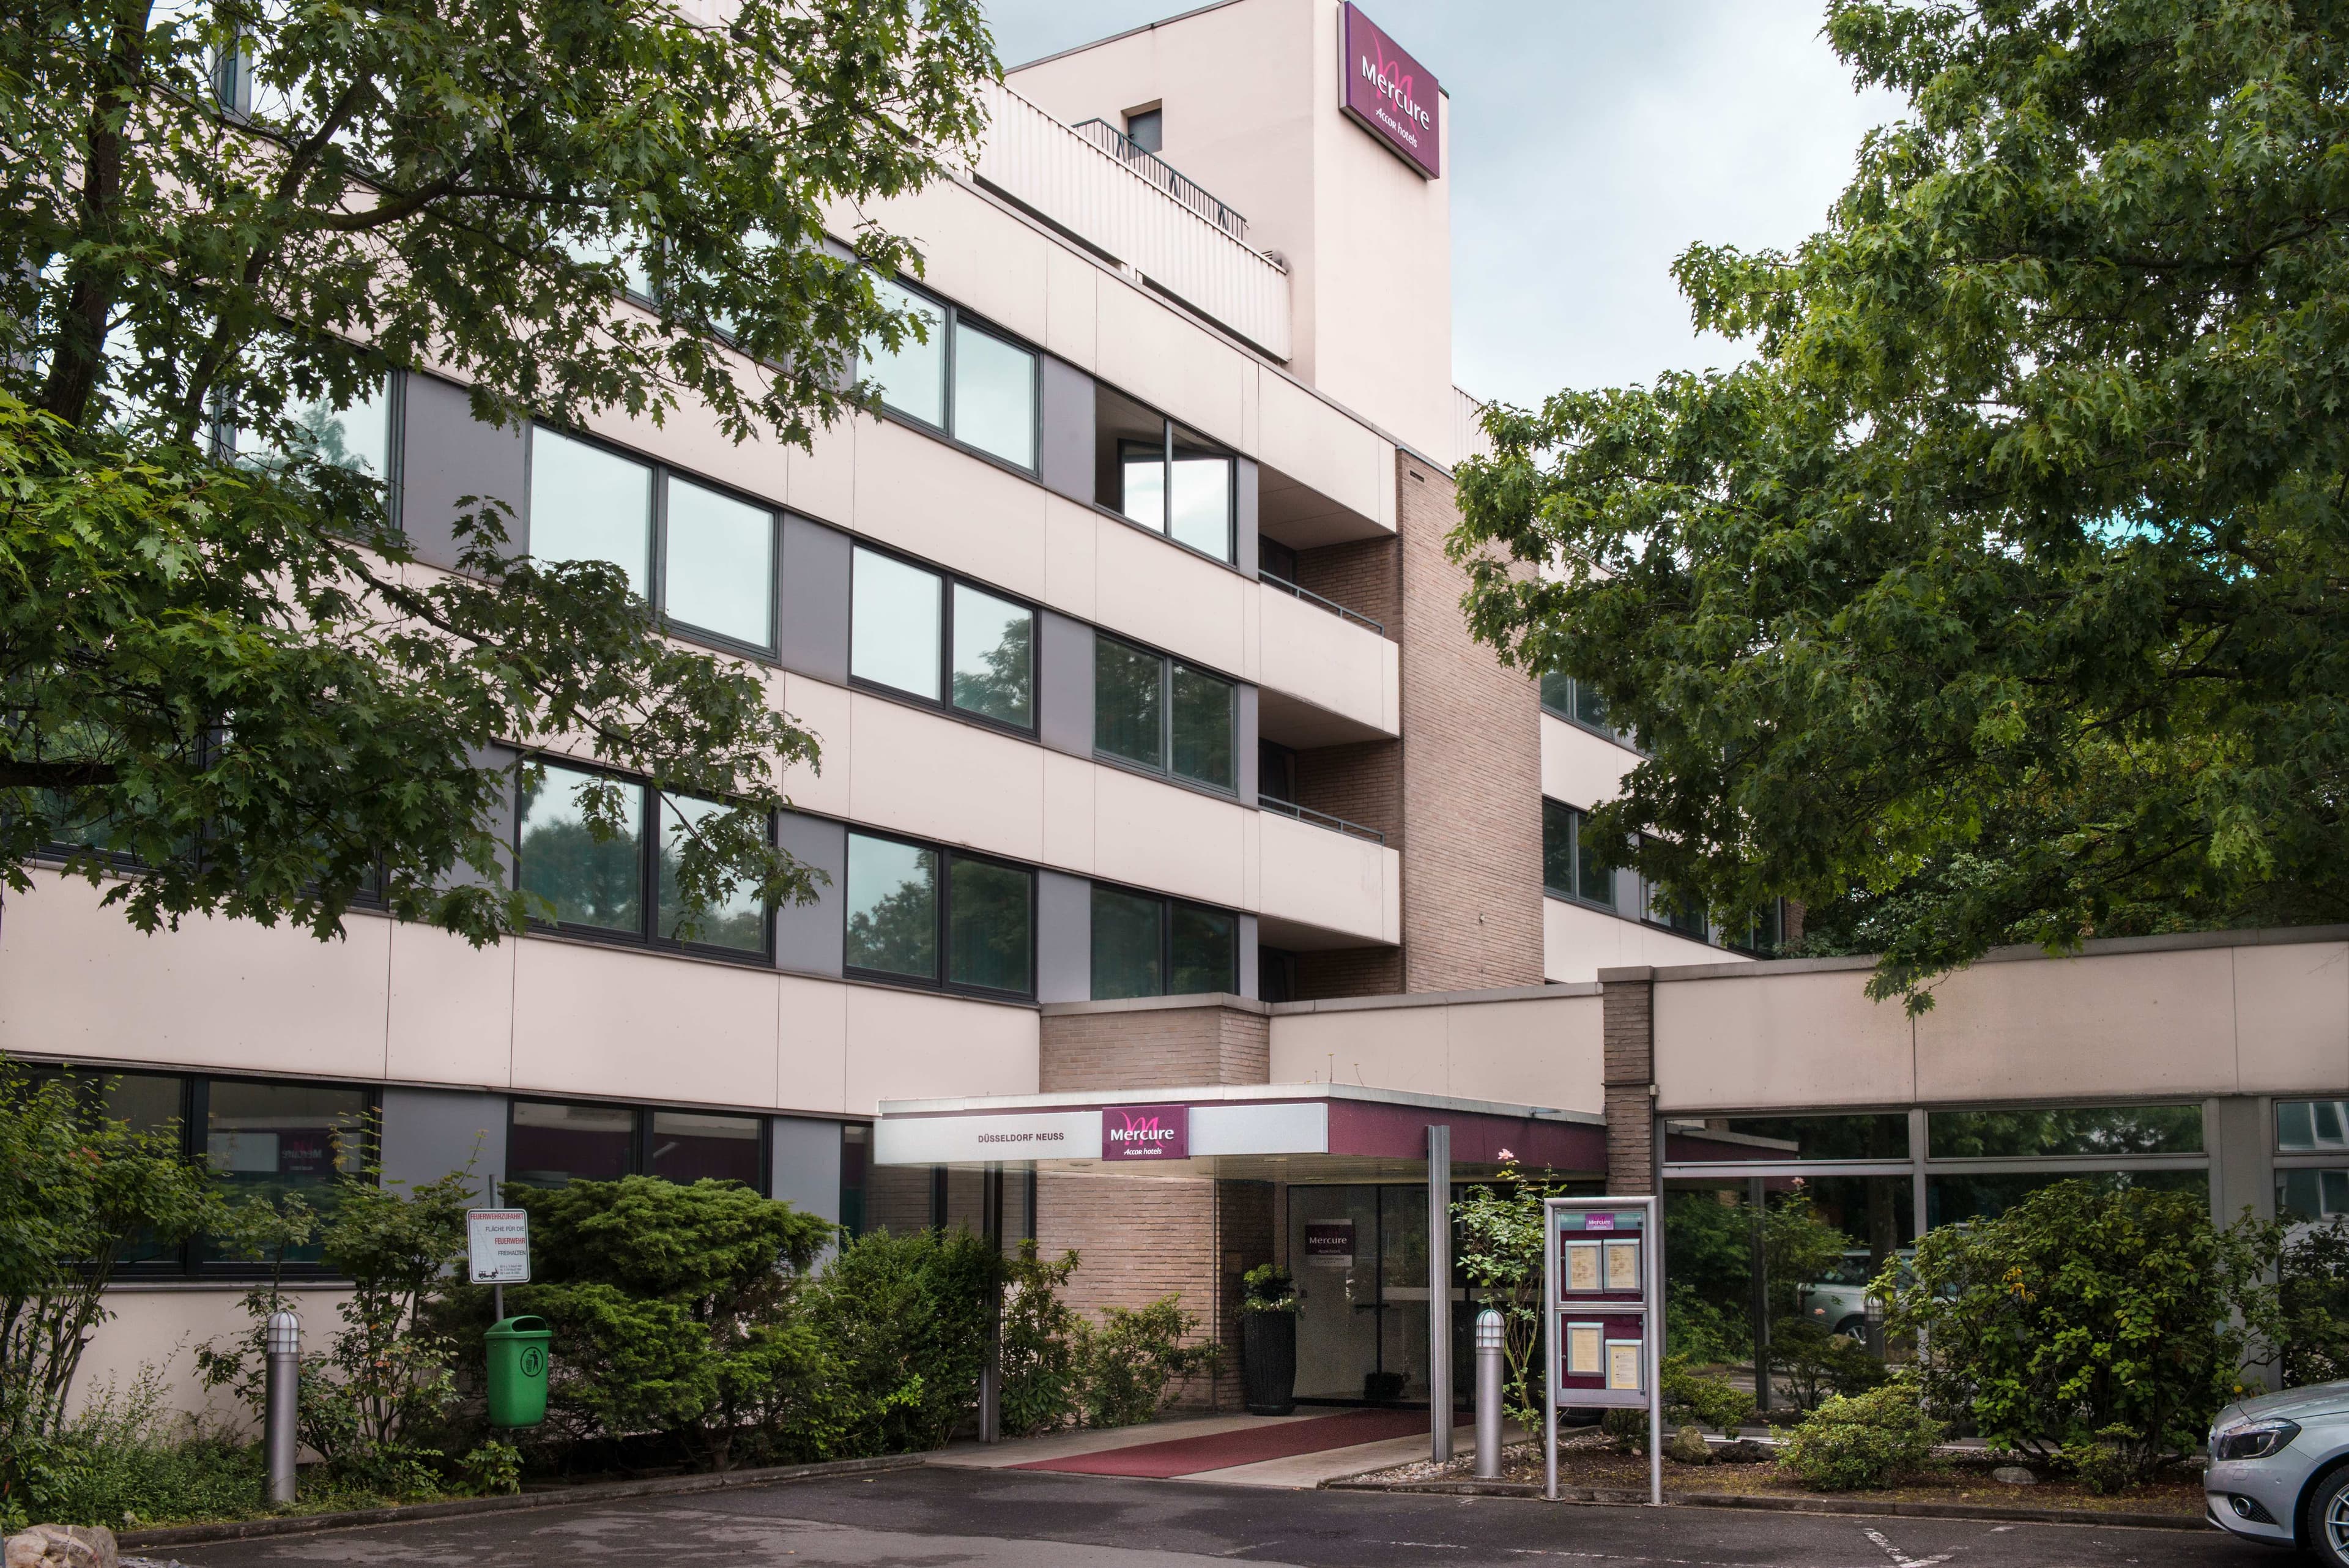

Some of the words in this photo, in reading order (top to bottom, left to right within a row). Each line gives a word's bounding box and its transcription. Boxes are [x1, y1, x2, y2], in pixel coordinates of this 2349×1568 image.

[1362, 55, 1429, 130] Mercure
[1397, 122, 1418, 148] hotels
[978, 1133, 1033, 1143] DÜSSELDORF
[1036, 1132, 1064, 1141] NEUSS
[1110, 1129, 1174, 1141] Mercure
